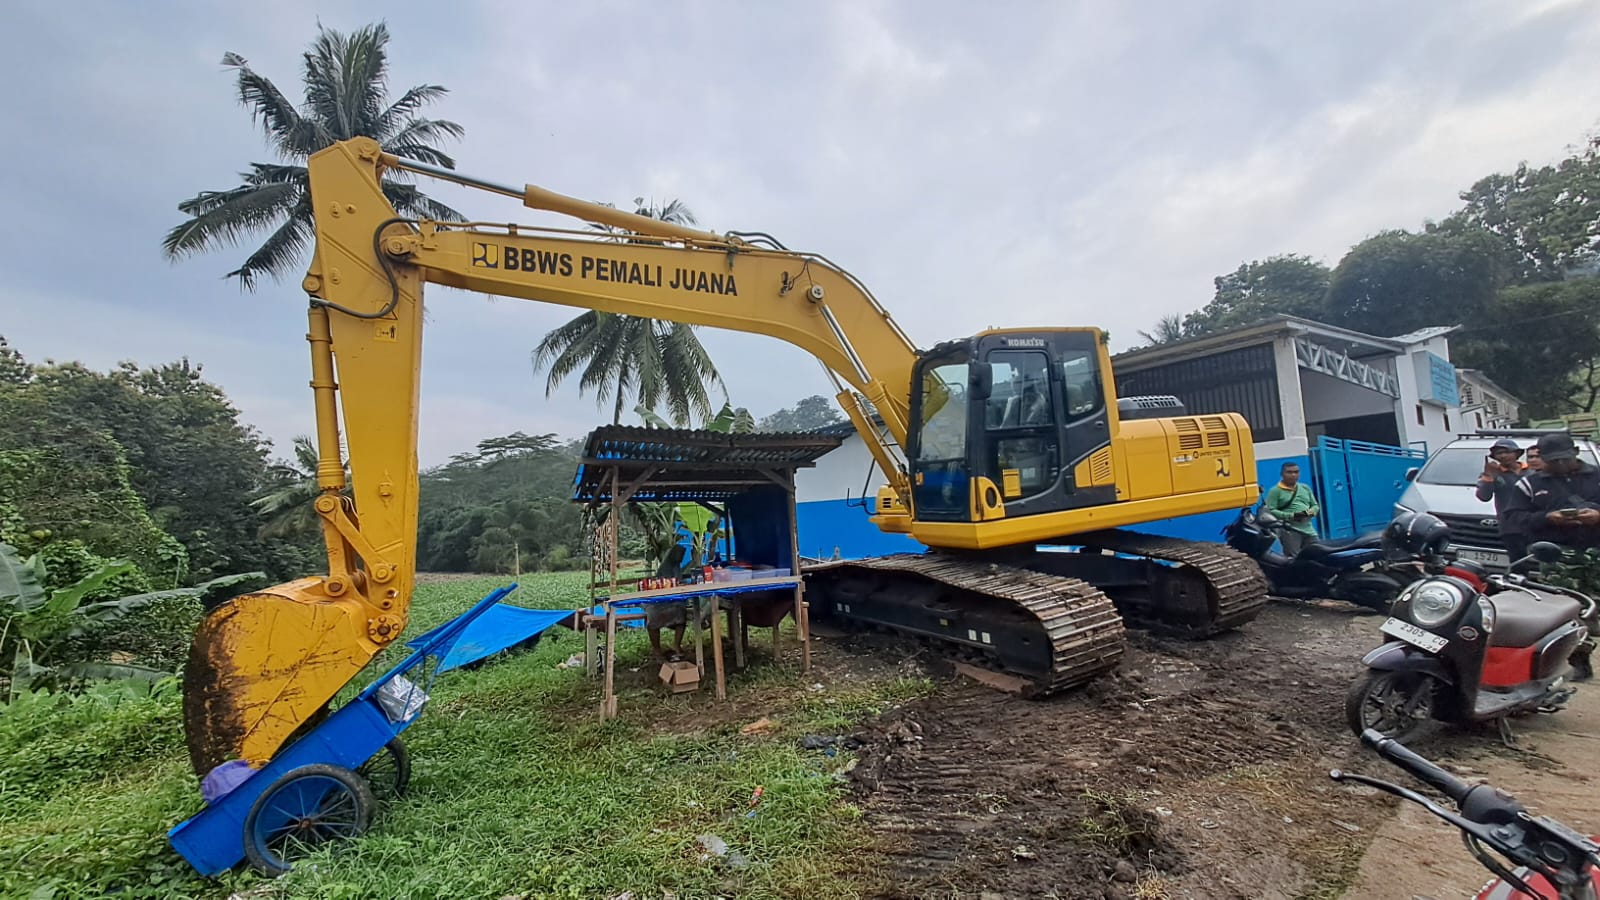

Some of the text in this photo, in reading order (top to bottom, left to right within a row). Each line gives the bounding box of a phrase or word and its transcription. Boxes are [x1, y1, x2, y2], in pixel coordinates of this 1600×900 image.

[504, 246, 738, 296] BBWS PEMALI JUANA
[1400, 623, 1425, 638] 2305
